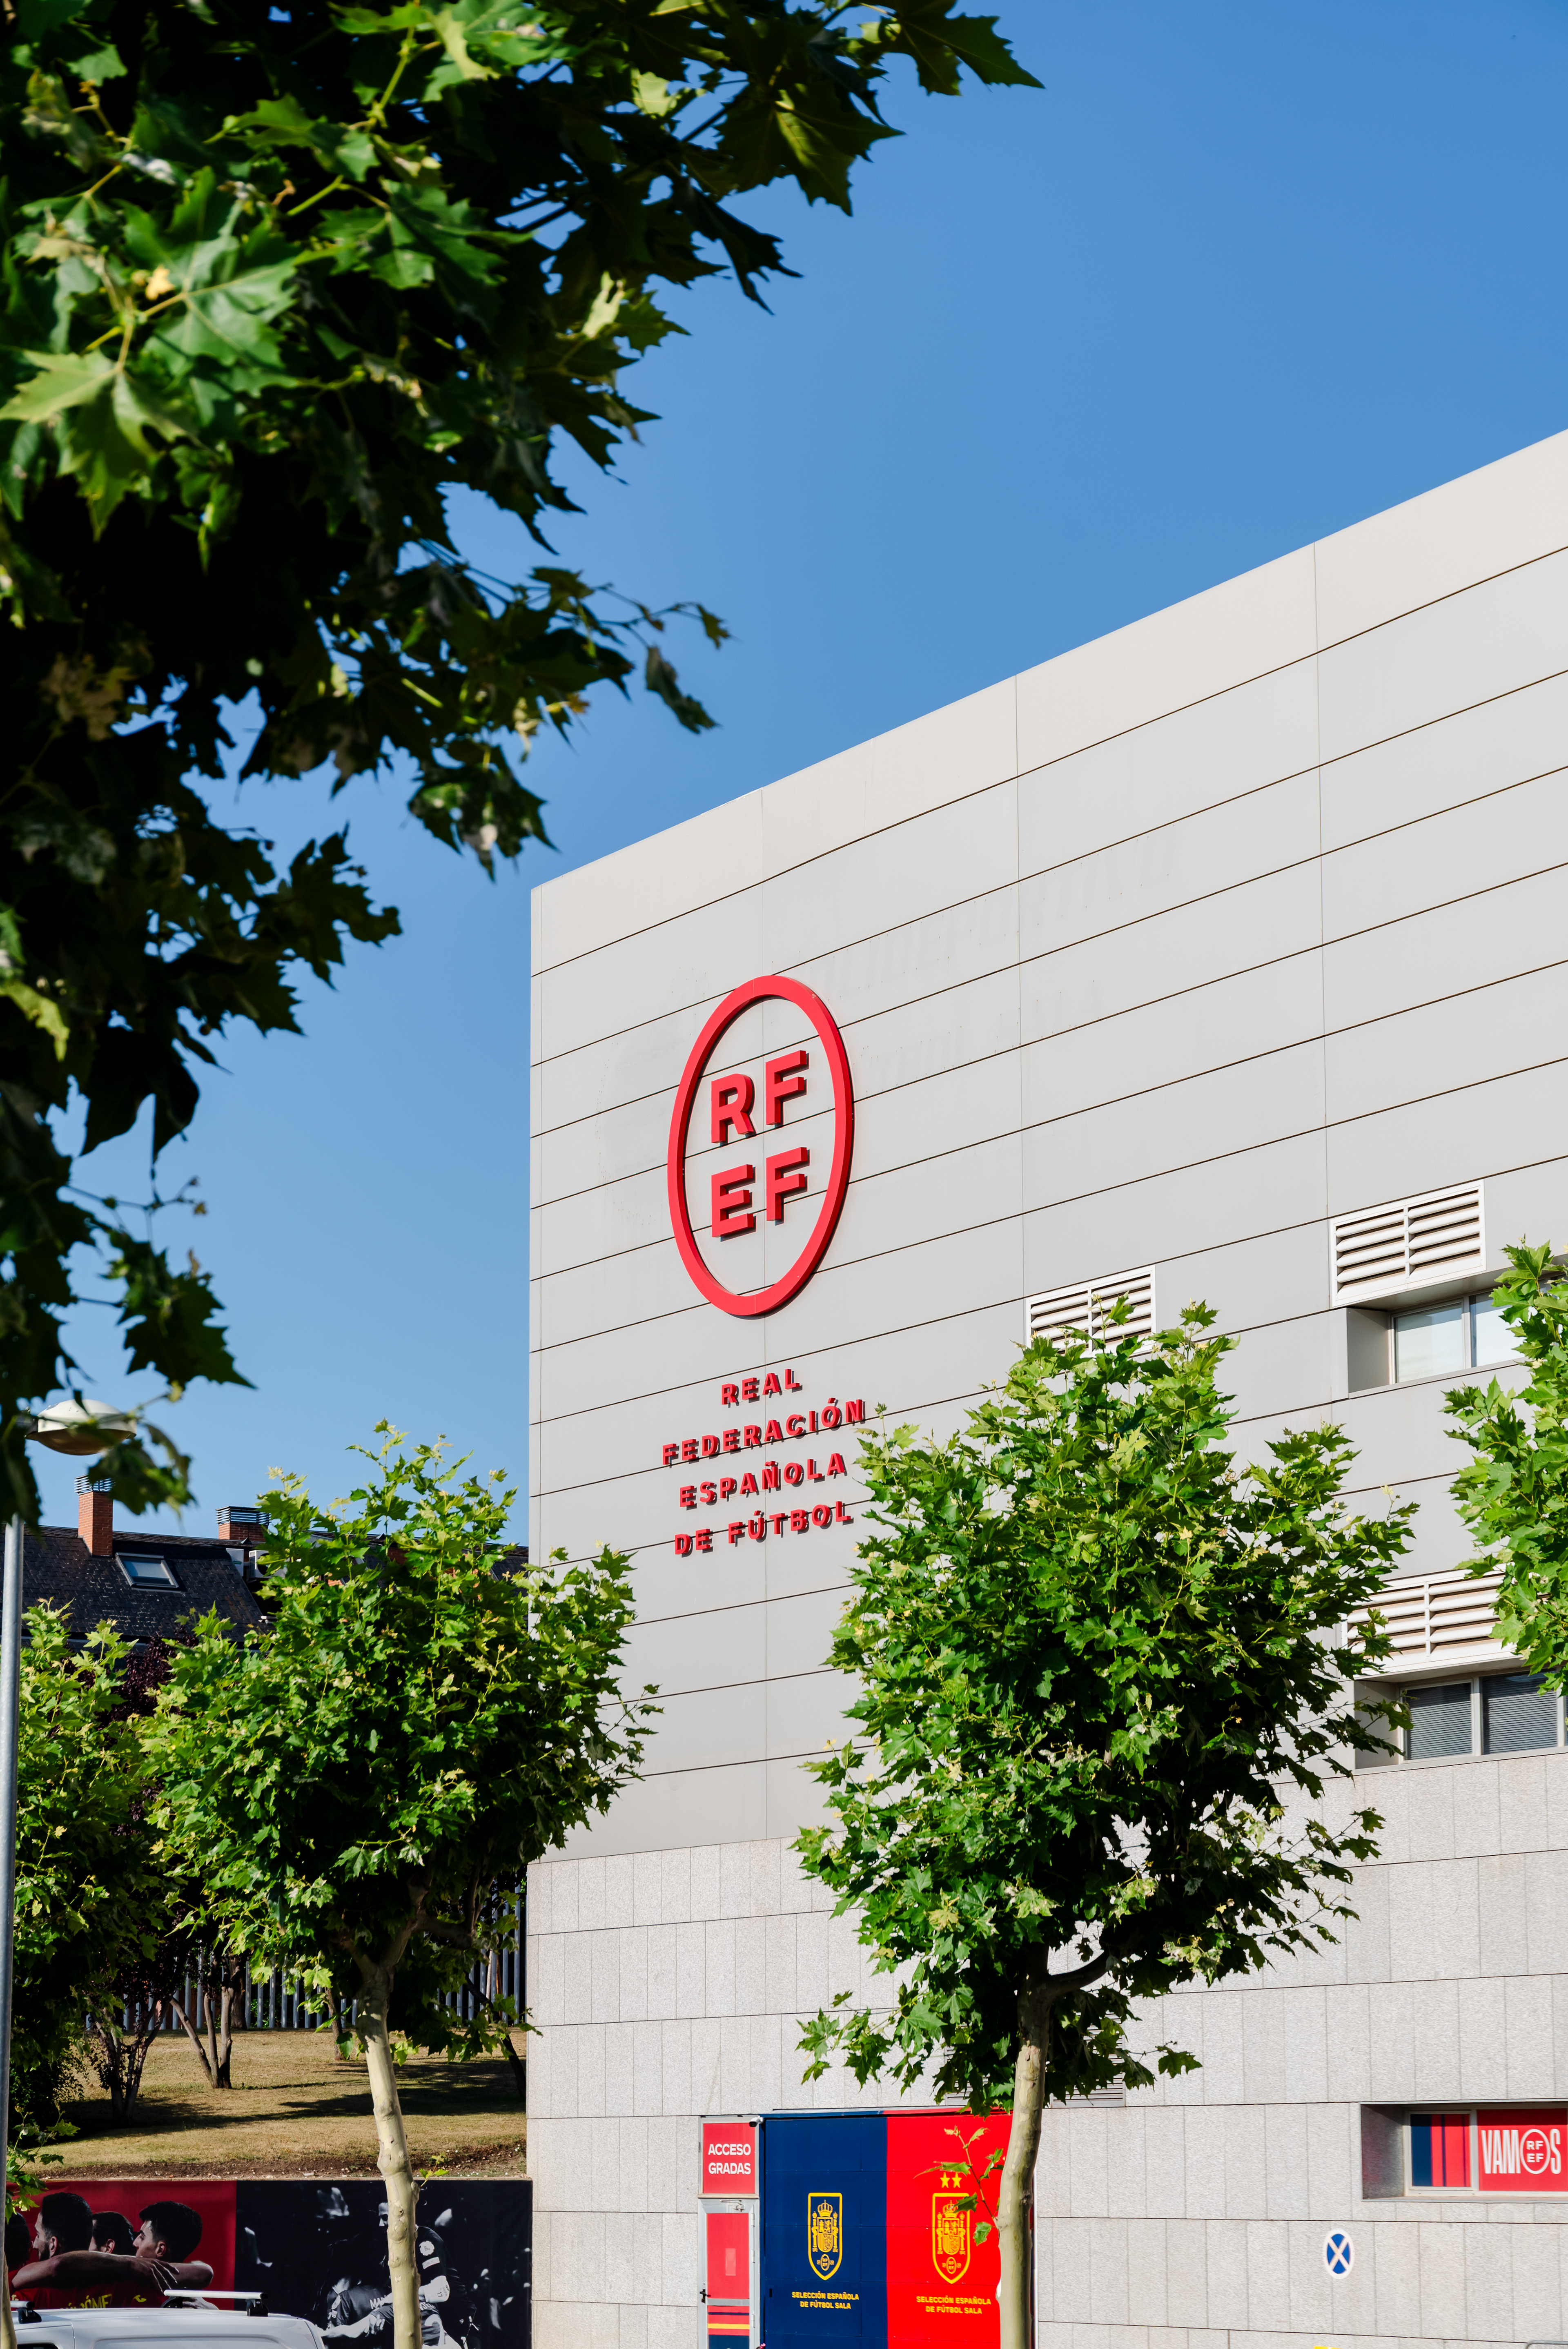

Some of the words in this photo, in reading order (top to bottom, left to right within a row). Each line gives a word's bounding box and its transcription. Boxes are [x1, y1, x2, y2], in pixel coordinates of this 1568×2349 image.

[722, 1369, 800, 1405] REAL
[662, 1397, 863, 1465] FEDERACIÓN
[680, 1453, 845, 1507] ESPAÑOLA
[675, 1529, 711, 1554] DE
[728, 1501, 851, 1544] FÚTBOL
[708, 2143, 751, 2155] ACCESO
[708, 2162, 751, 2175] GRADAS
[792, 2291, 826, 2299] SELECCIÓN
[827, 2292, 859, 2300] ESPAÑOLA
[916, 2295, 954, 2303] SELECCIÓN
[955, 2296, 991, 2304] ESPAÑOLA
[810, 2300, 834, 2308] FÚTBOL
[936, 2304, 963, 2313] FÚTBOL
